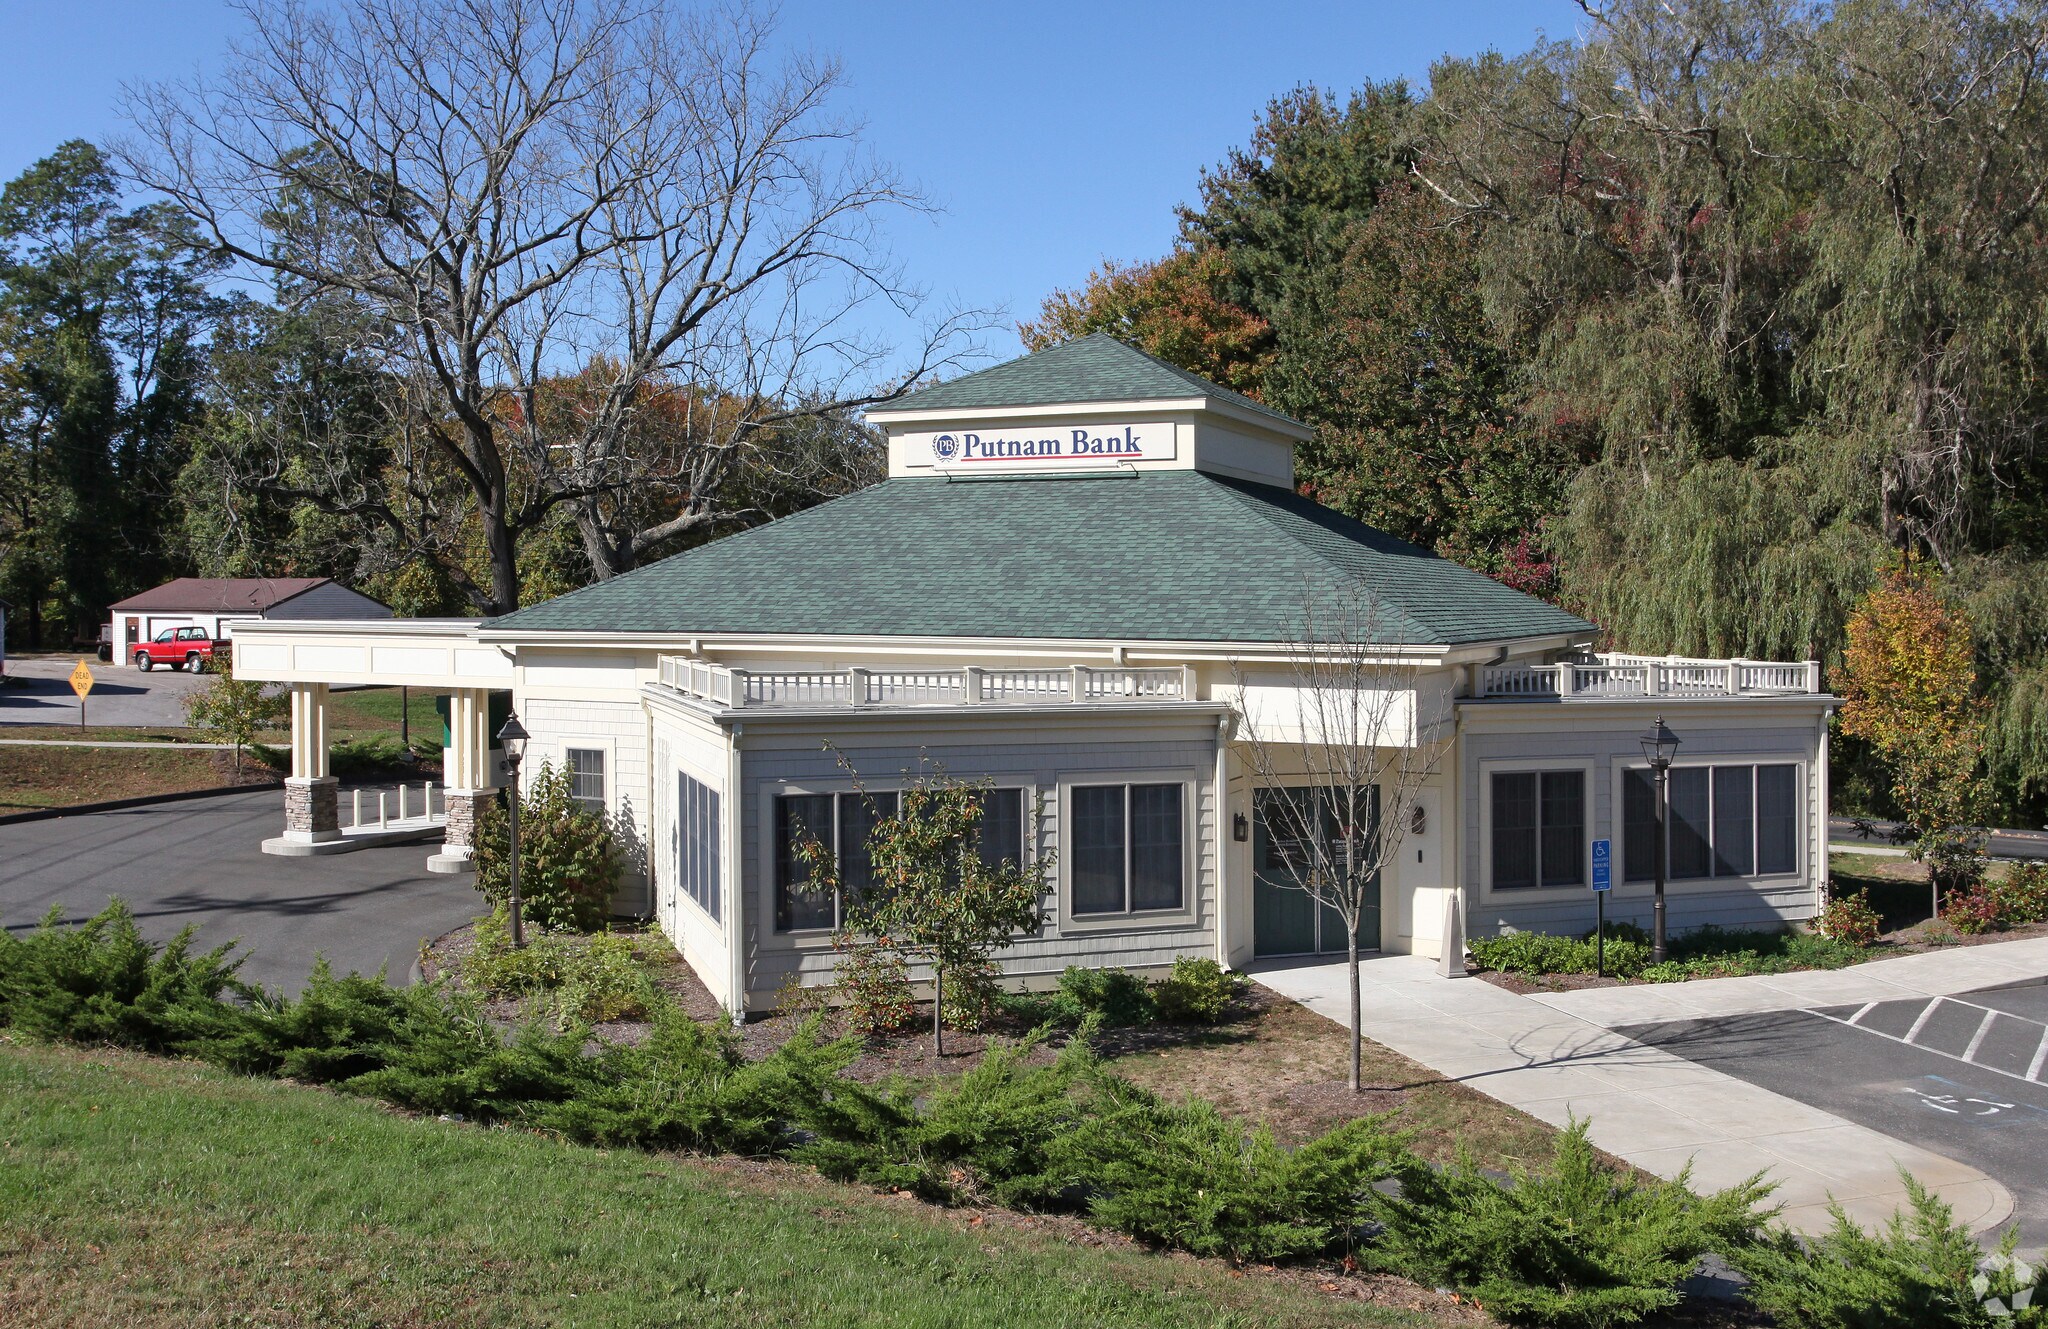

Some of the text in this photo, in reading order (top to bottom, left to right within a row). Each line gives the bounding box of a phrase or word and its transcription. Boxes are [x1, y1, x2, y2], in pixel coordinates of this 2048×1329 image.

[939, 440, 954, 452] PB
[963, 426, 1142, 457] Putnam Bank
[75, 671, 90, 680] DEAD
[77, 682, 88, 690] END
